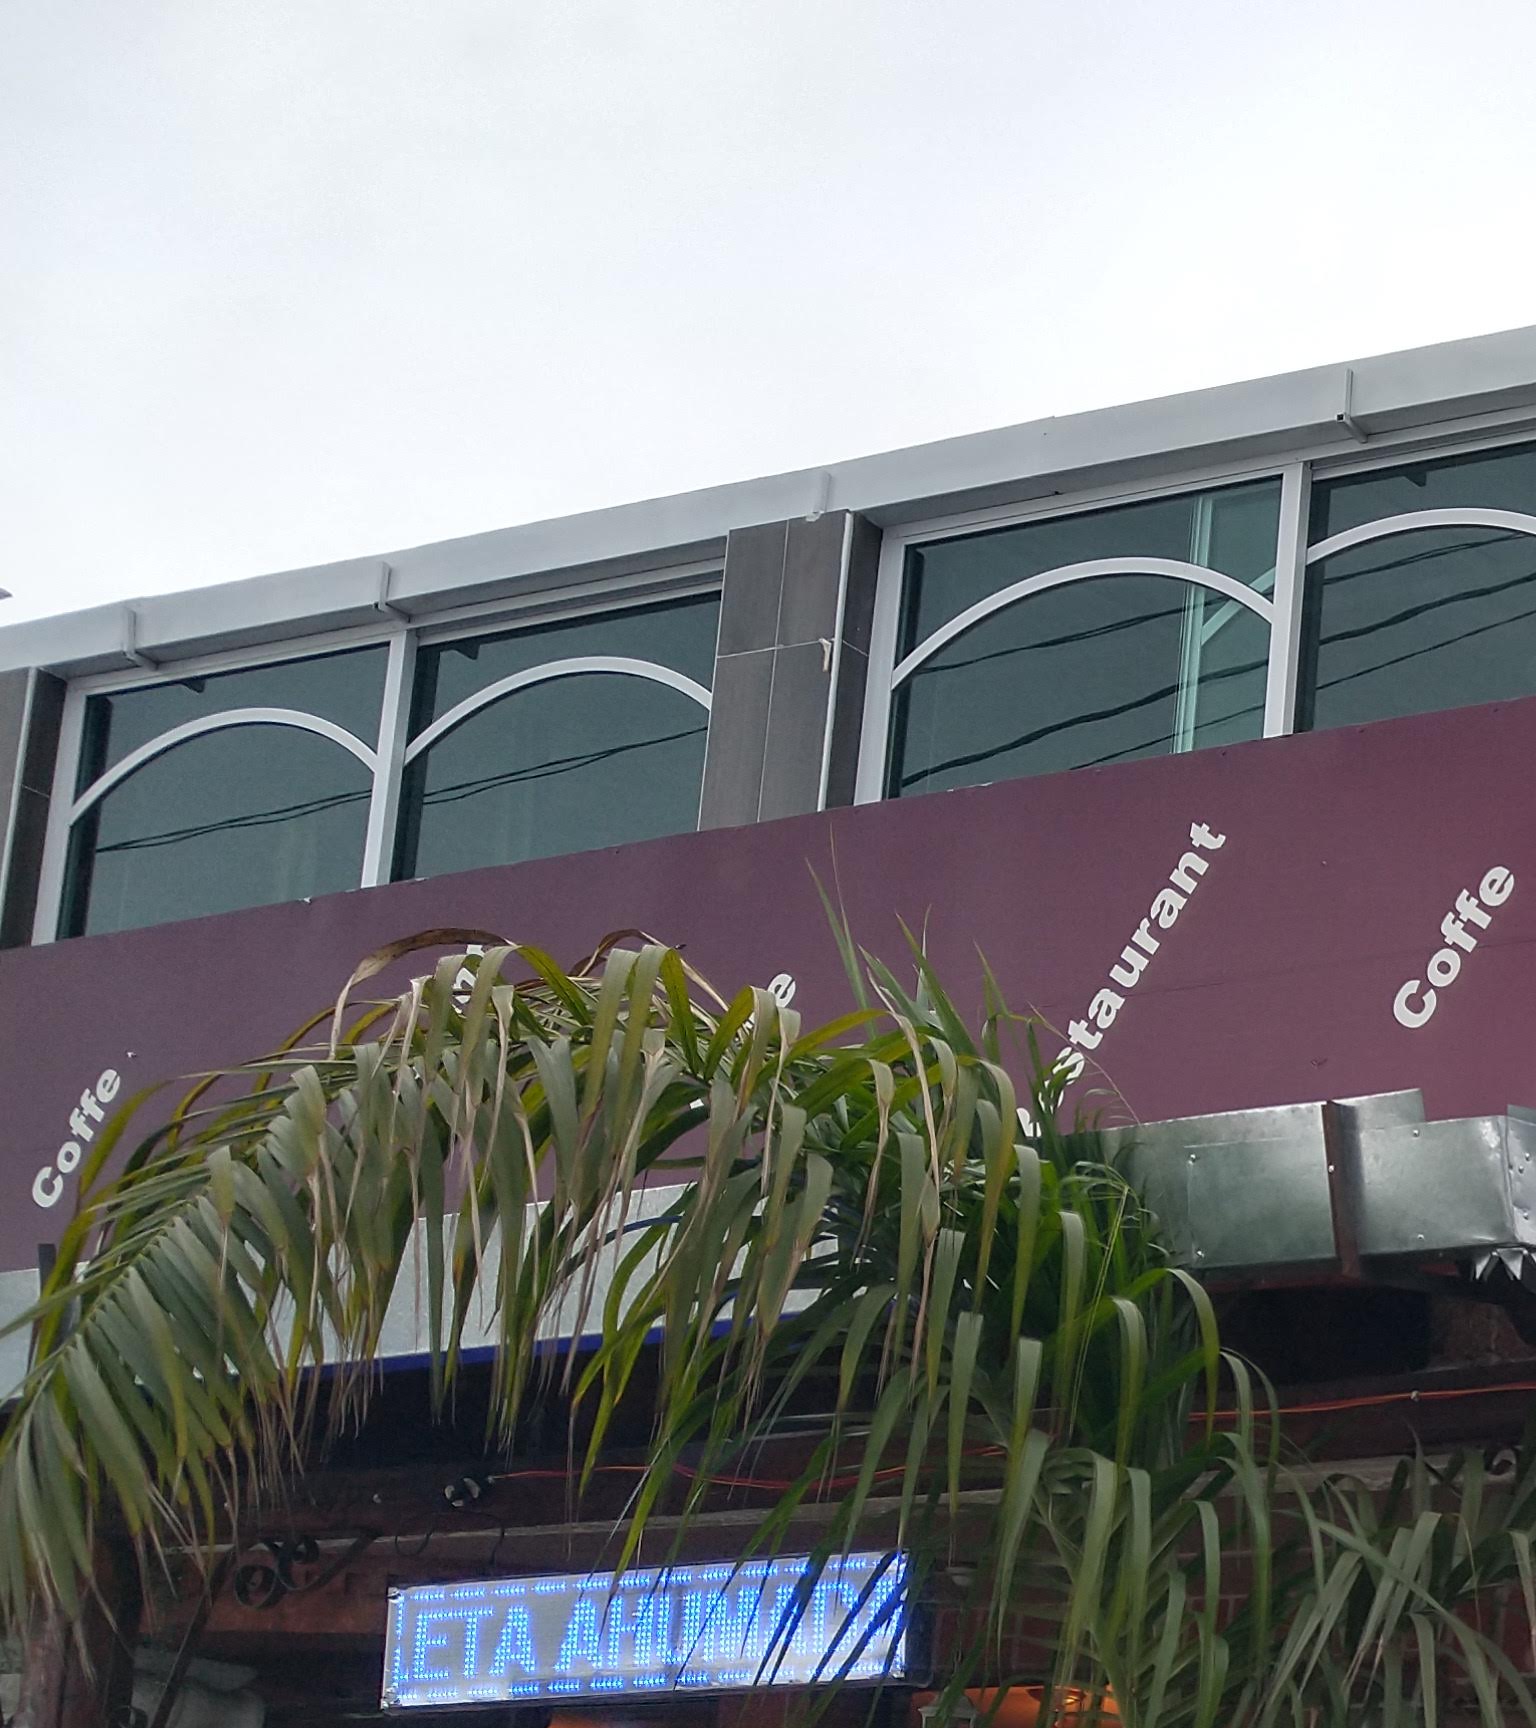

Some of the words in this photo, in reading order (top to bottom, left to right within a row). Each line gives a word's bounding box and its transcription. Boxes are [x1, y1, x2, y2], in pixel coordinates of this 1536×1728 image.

[1016, 821, 1227, 1138] staurant
[1392, 864, 1516, 1031] Coffe
[32, 1069, 121, 1207] Coffe
